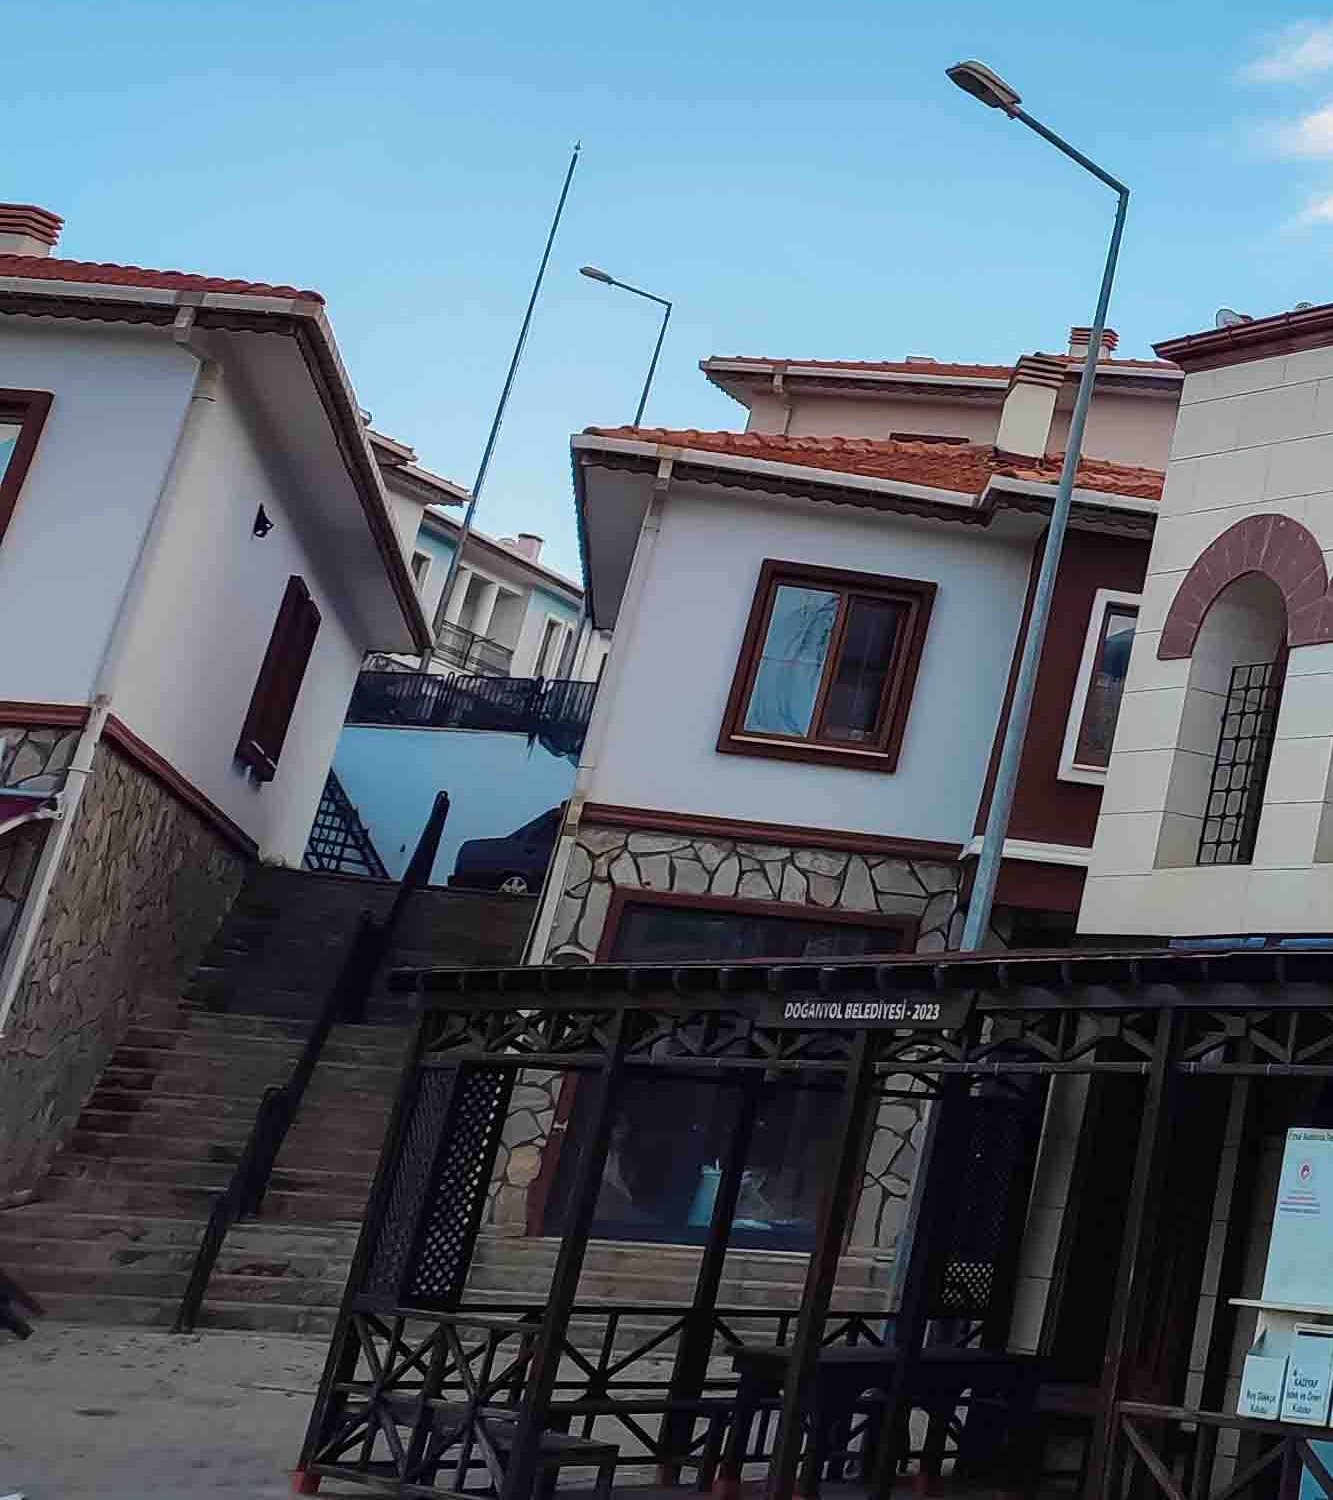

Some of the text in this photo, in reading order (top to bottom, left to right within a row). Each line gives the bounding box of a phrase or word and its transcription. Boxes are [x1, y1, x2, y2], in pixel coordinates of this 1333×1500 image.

[784, 999, 843, 1019] DOĞANYOL
[844, 999, 907, 1020] BELEDİYESİ
[912, 1003, 940, 1020] 2023
